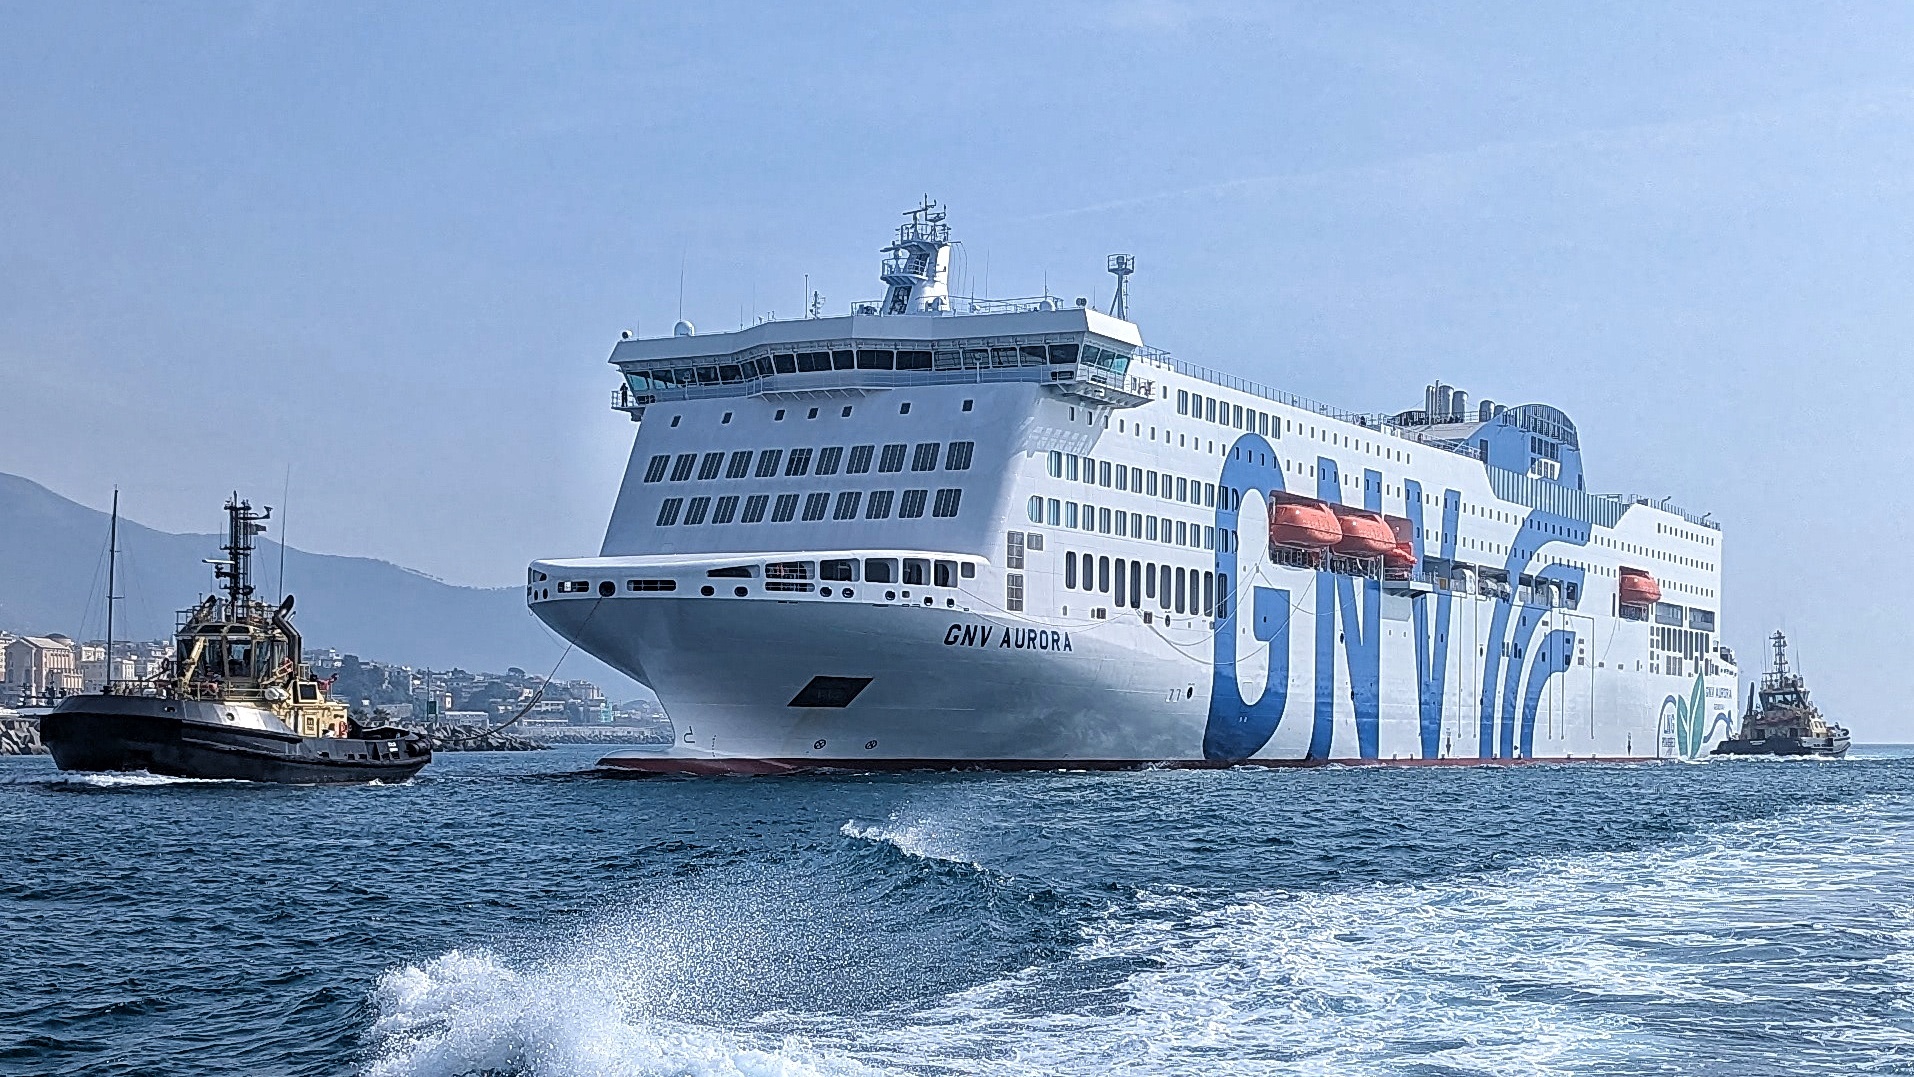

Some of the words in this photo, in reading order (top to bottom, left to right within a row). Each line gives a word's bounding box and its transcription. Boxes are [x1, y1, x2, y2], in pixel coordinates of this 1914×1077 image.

[943, 623, 993, 648] GNV
[999, 626, 1073, 652] AURORA
[1203, 433, 1461, 760] GNV
